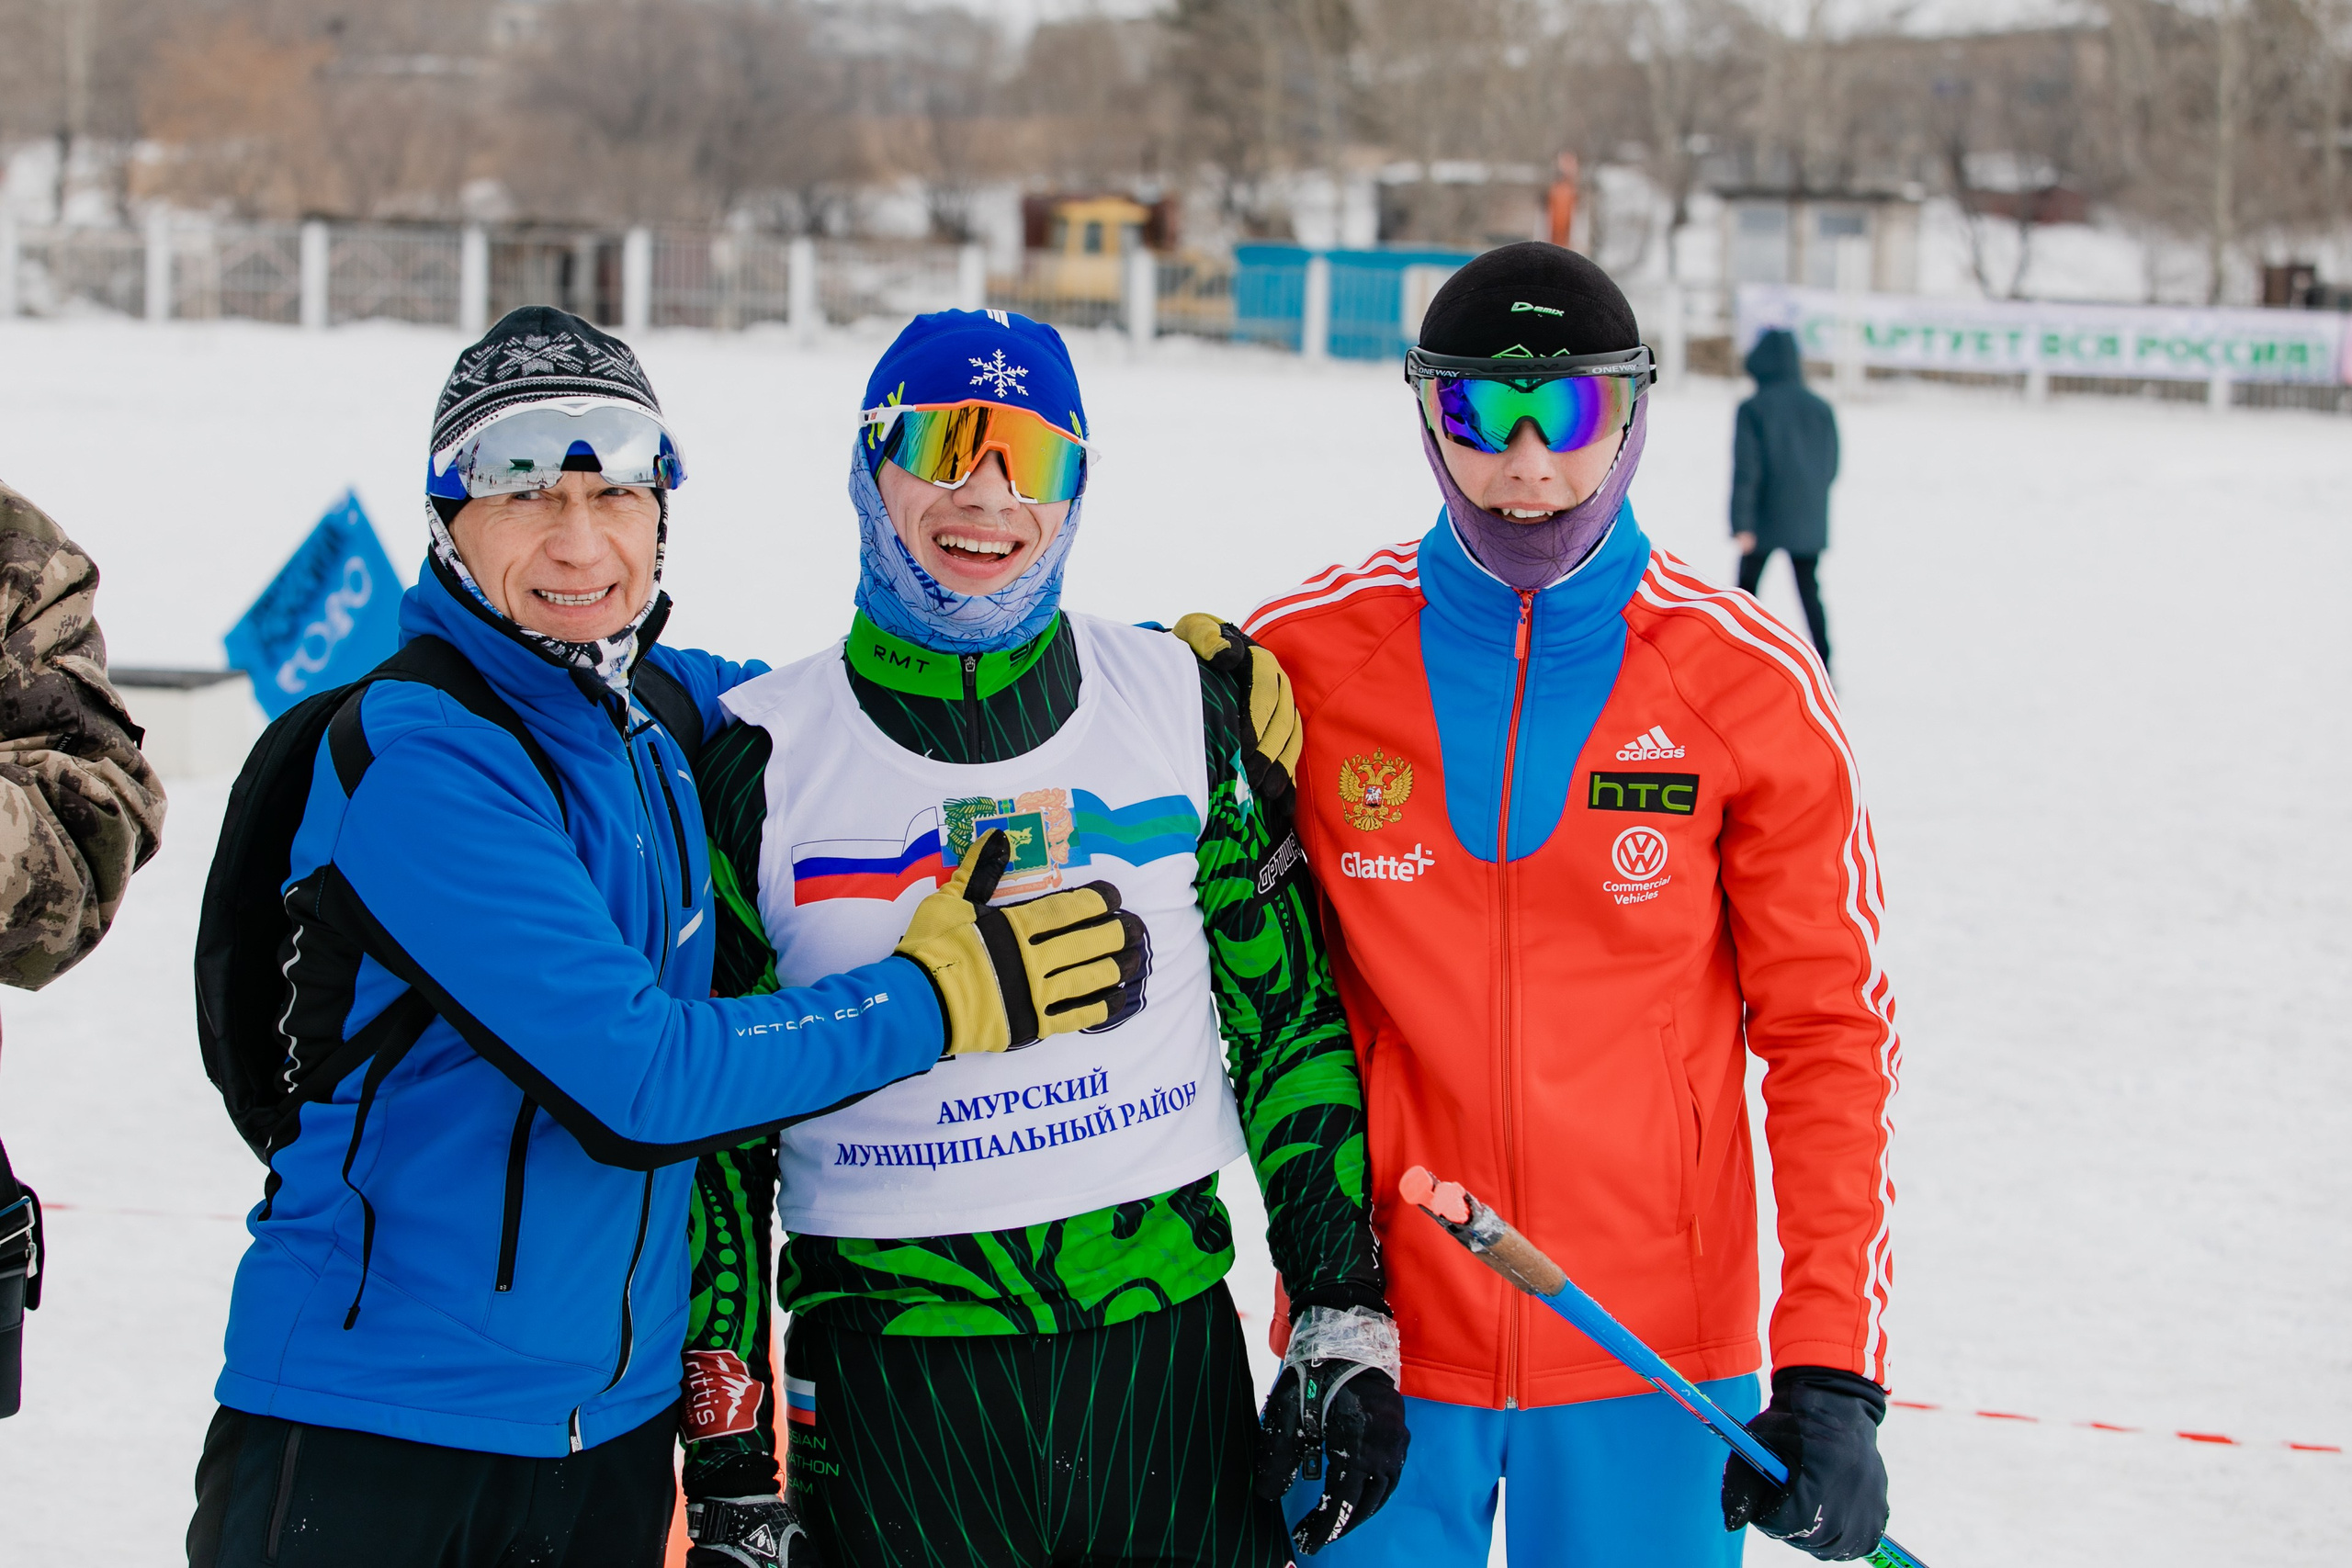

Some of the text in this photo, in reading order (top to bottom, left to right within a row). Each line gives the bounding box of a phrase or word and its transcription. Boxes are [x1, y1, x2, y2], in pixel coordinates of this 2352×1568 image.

[1510, 301, 1565, 317] Demix
[2041, 333, 2120, 359] ВСЯ
[874, 644, 930, 673] RMT
[1616, 748, 1685, 761] adidas
[1602, 874, 1671, 892] Commercial
[1613, 890, 1658, 905] Vehicles
[834, 992, 889, 1021] CODE
[936, 1066, 1110, 1125] АМУРСКИЙ
[833, 1080, 1197, 1171] МУНИЦИПАЛЬНЫЙ РАЙОН
[685, 1361, 717, 1426] rittis
